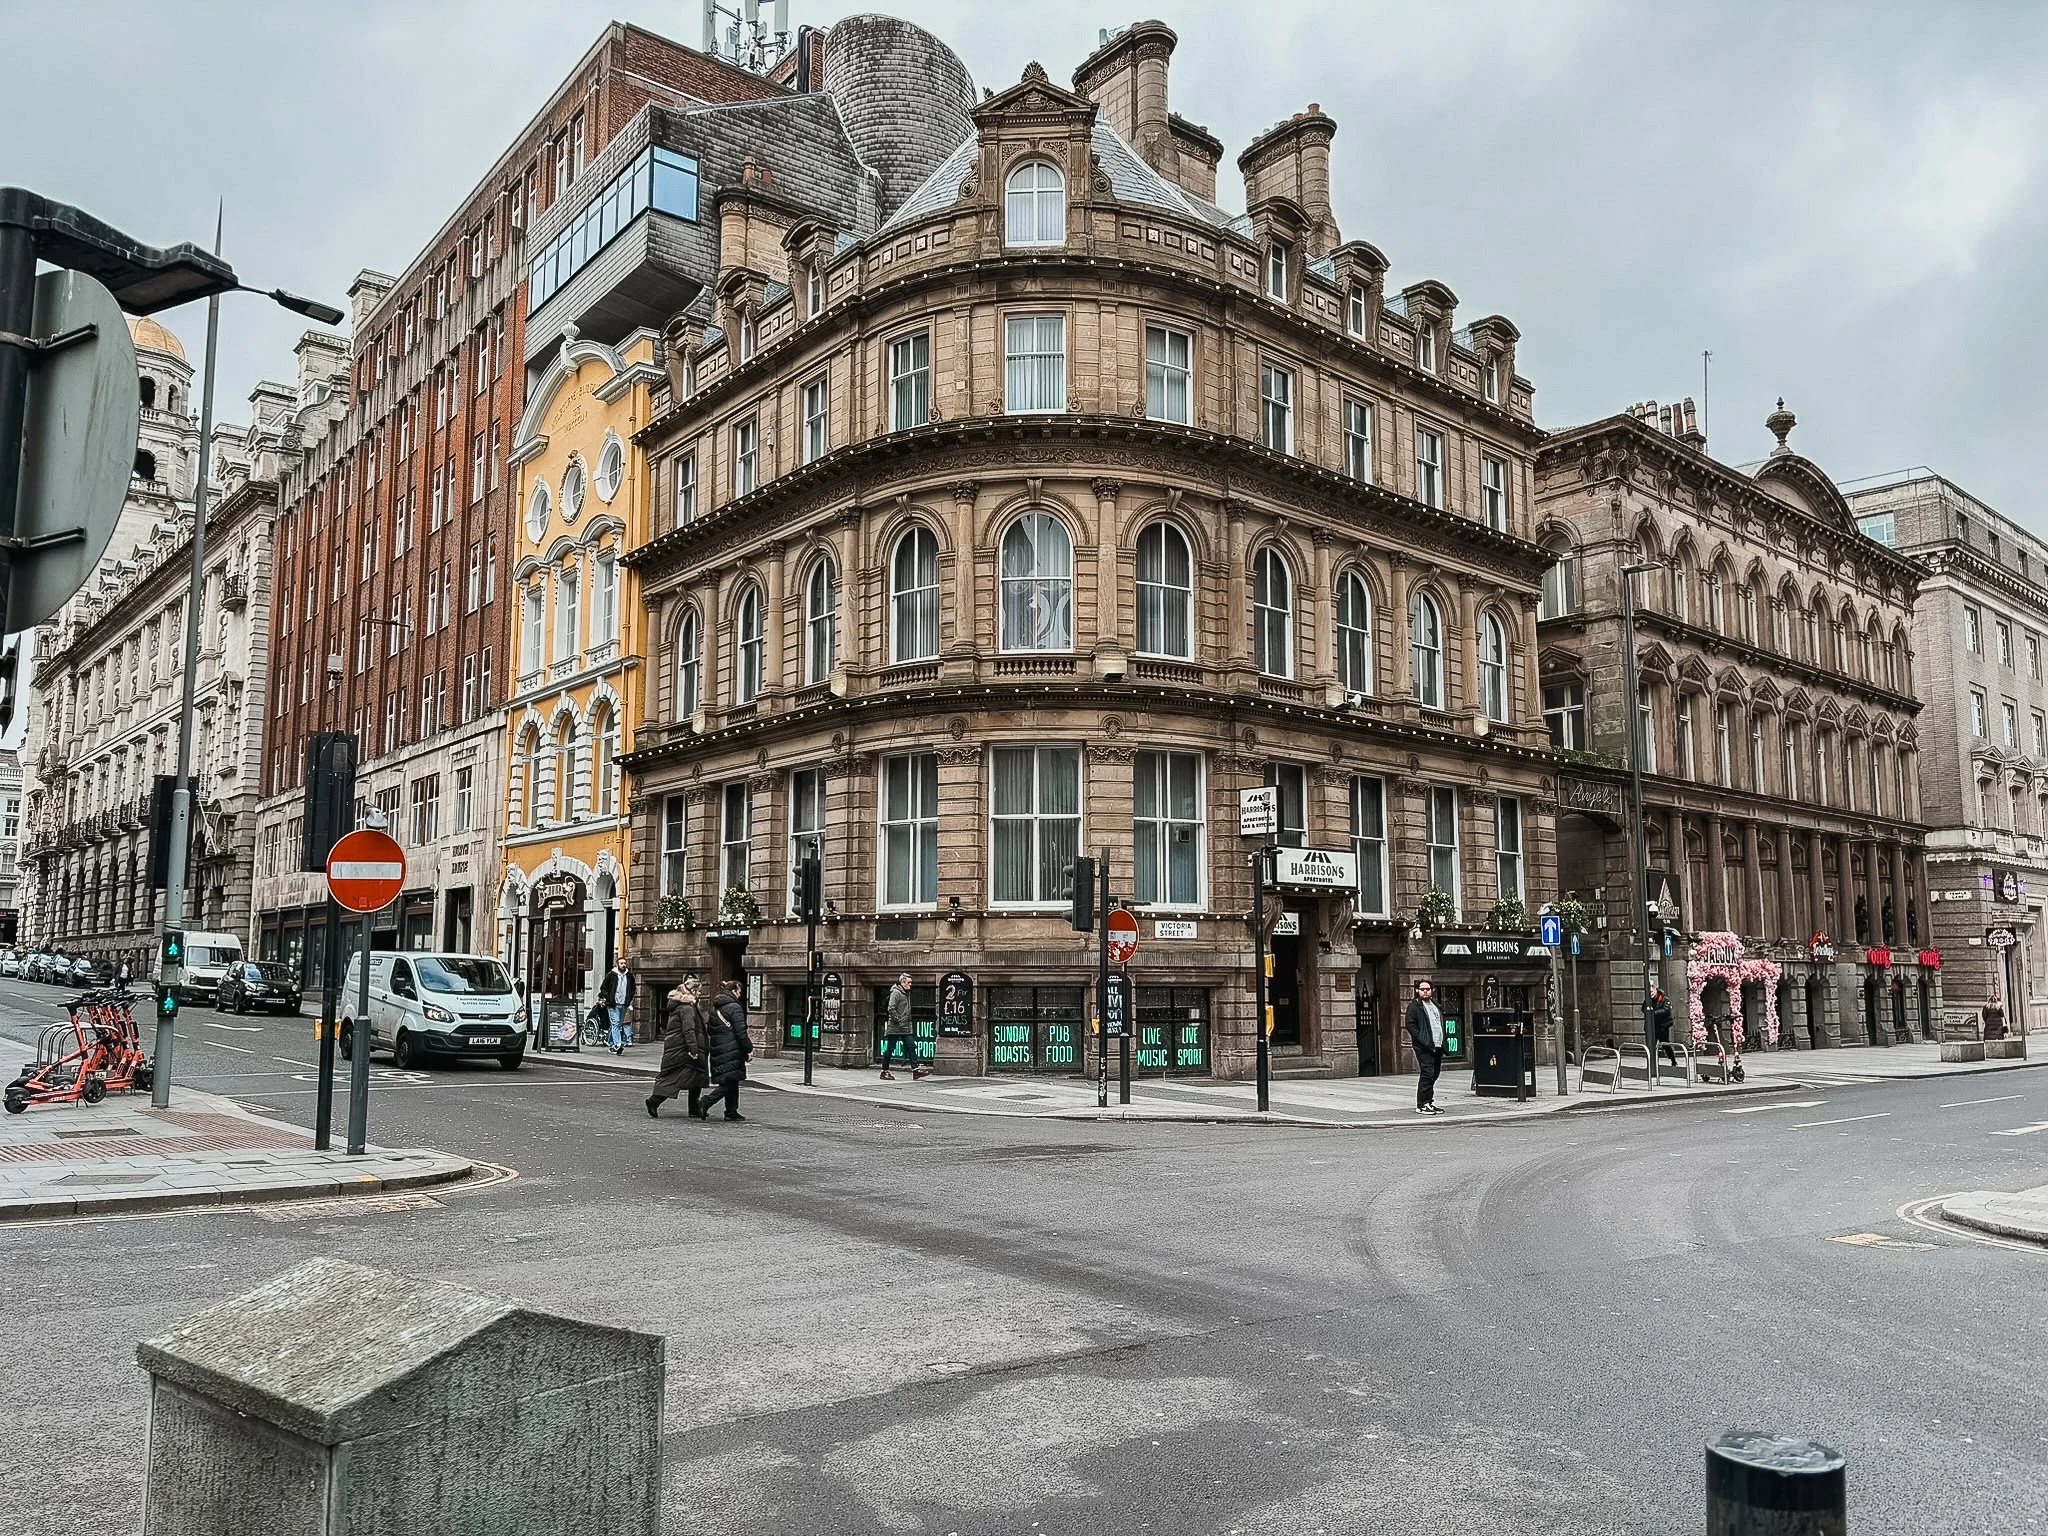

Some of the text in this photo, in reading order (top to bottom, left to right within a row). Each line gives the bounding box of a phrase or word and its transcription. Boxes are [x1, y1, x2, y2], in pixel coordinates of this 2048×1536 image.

[1569, 783, 1613, 808] Angels
[1241, 804, 1276, 815] HARRISS
[1290, 862, 1345, 879] HARRISONS
[1160, 922, 1192, 930] VICTORIA
[1476, 940, 1520, 955] HARRISONS
[945, 984, 956, 1000] 2
[940, 1014, 968, 1025] MEALS
[916, 1021, 935, 1038] LIVE
[994, 1025, 1030, 1043] SUNDAY
[1049, 1025, 1070, 1043] PUB
[1142, 1027, 1162, 1045] LIVE
[1181, 1026, 1199, 1044] LIVE
[994, 1045, 1030, 1063] ROASTS
[1045, 1045, 1073, 1063] FOOD
[1137, 1049, 1168, 1067] MUSIC
[1177, 1048, 1203, 1066] SPORT
